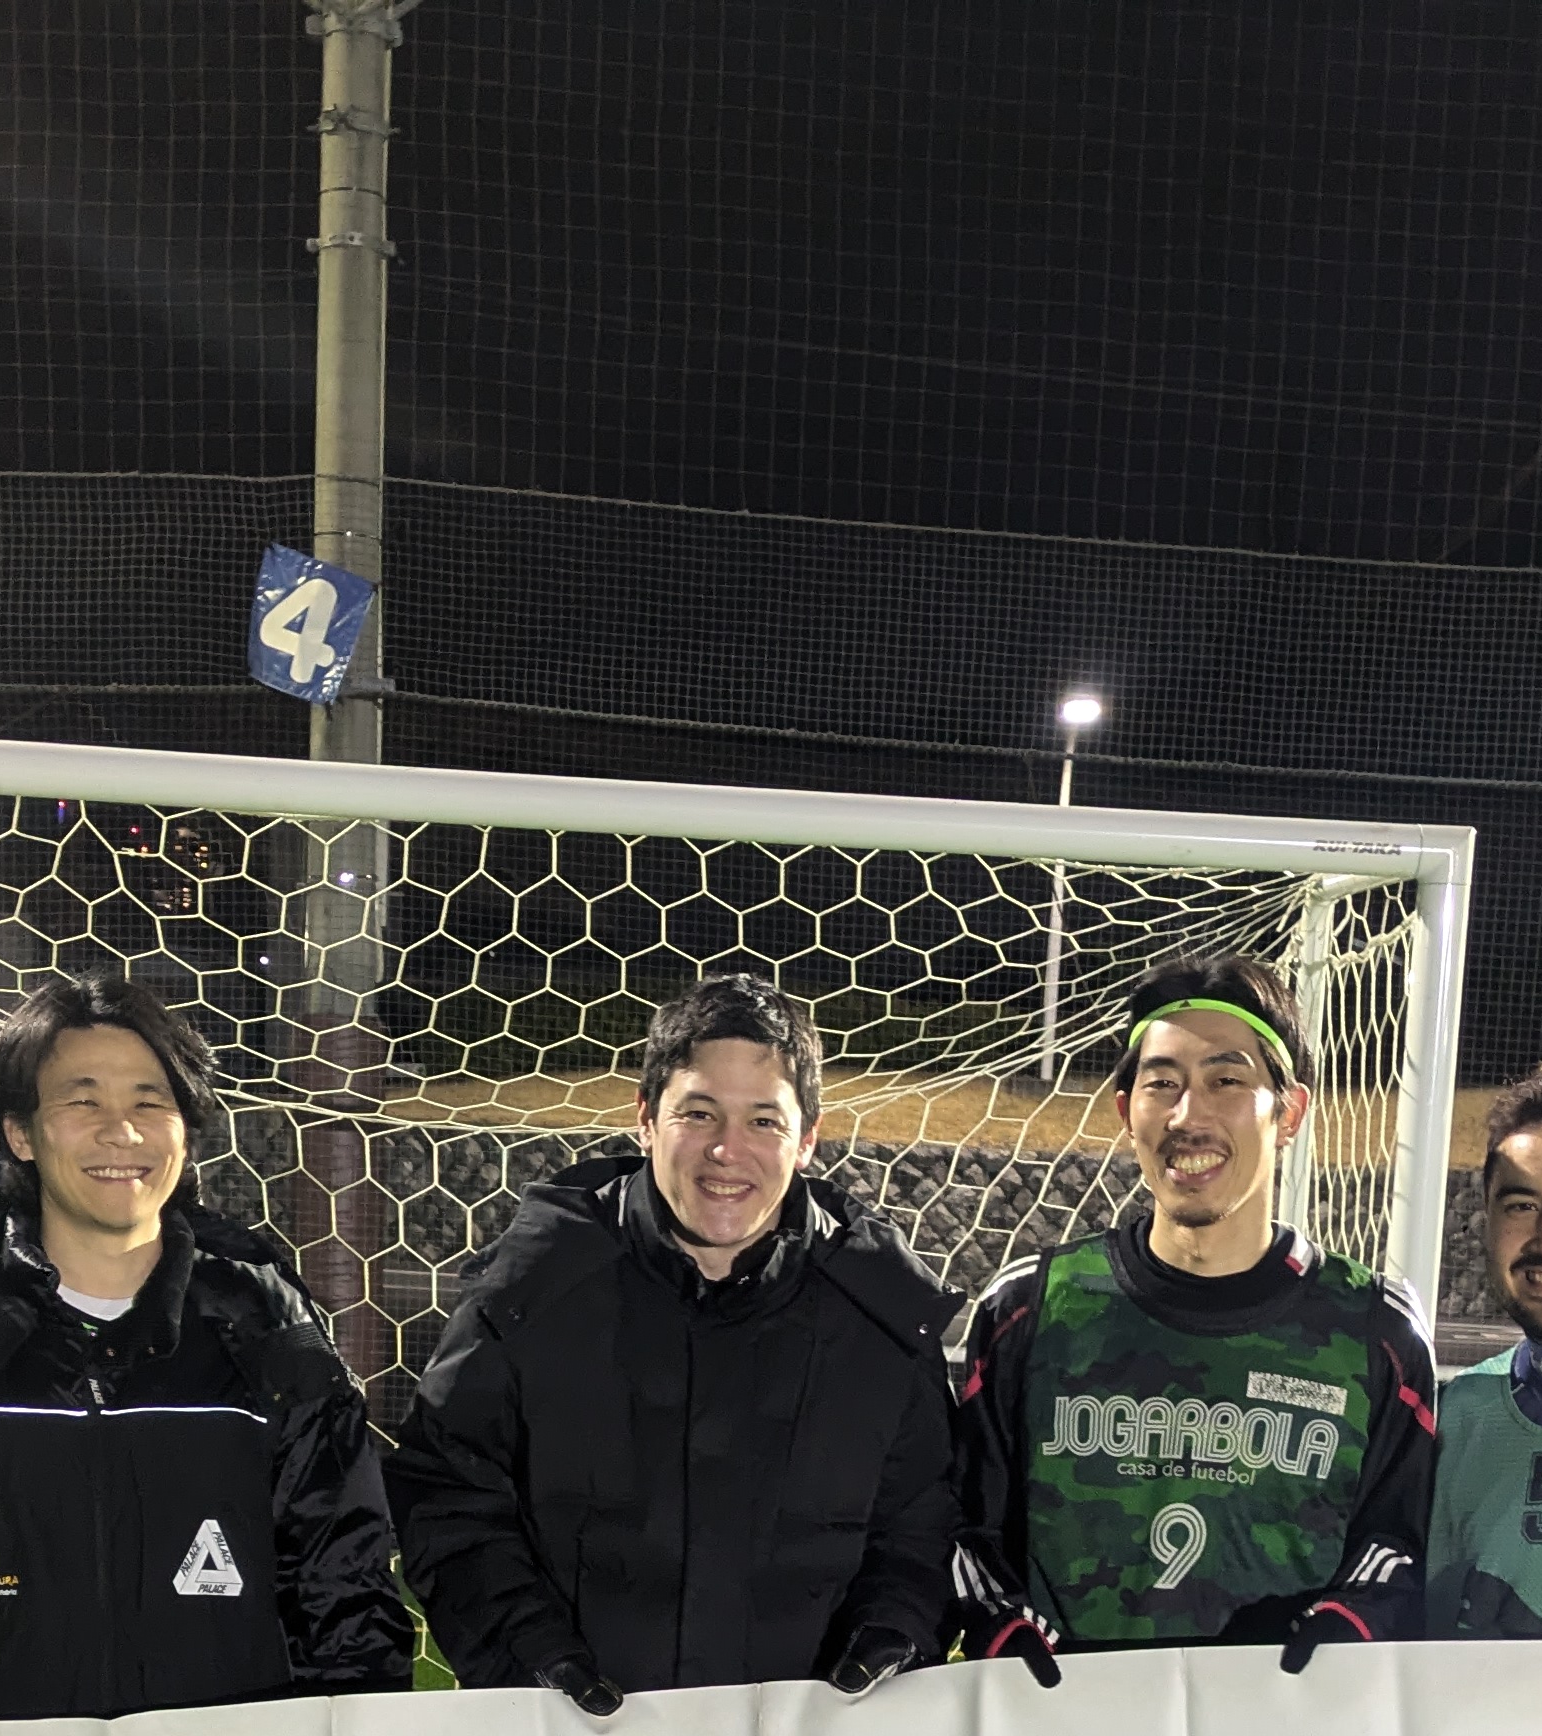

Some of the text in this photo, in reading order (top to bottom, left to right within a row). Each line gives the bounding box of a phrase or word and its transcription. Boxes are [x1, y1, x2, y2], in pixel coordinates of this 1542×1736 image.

[259, 578, 338, 684] 4
[1041, 1394, 1340, 1480] JOGARBOLA
[1116, 1460, 1257, 1487] casa de futebol
[179, 1540, 202, 1578] PALACE
[212, 1531, 235, 1566] PALACE
[1149, 1502, 1208, 1590] 9
[197, 1583, 228, 1595] PALACE
